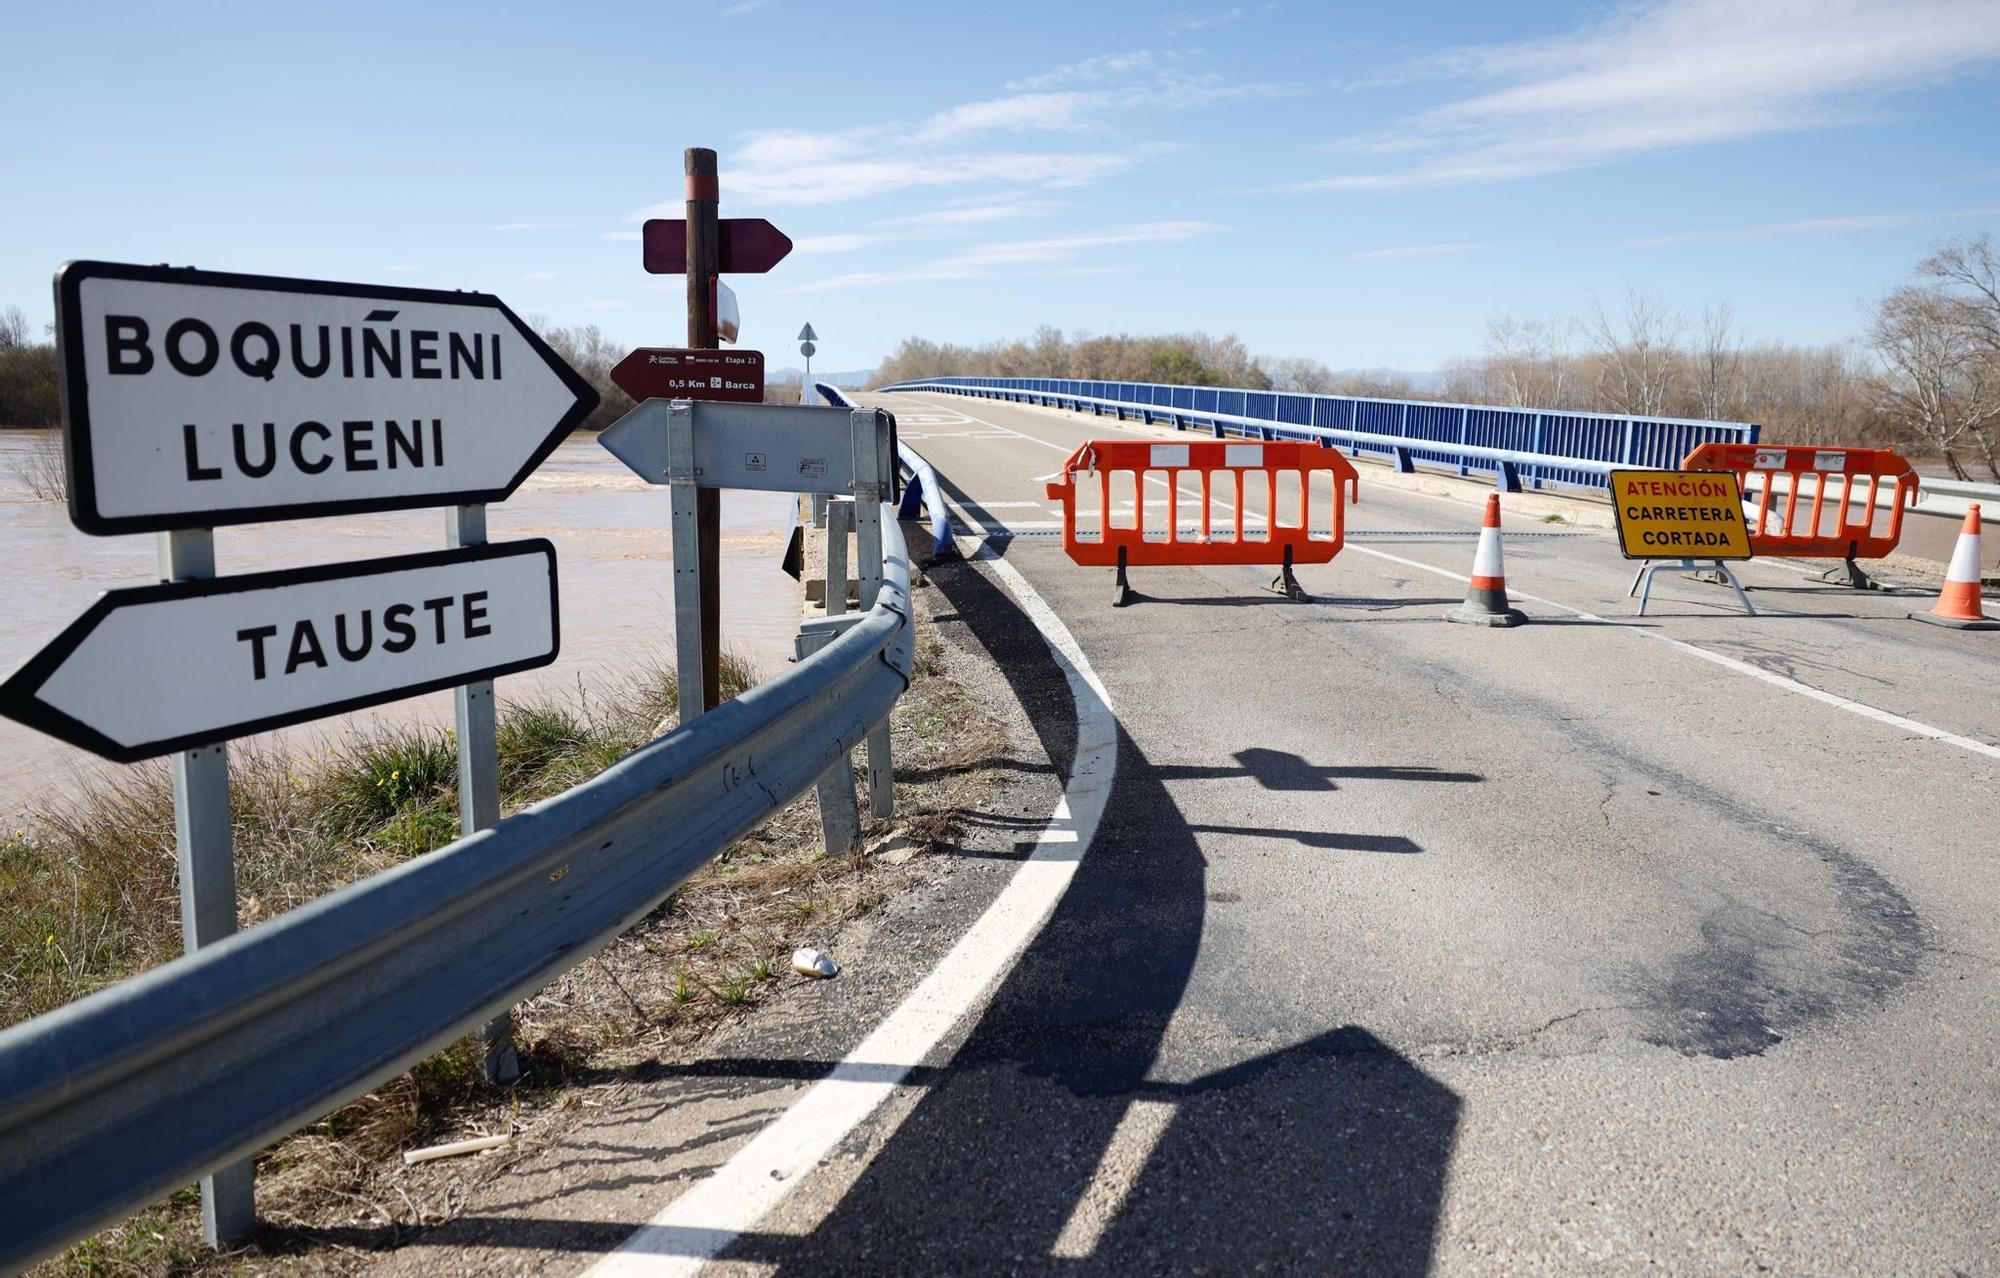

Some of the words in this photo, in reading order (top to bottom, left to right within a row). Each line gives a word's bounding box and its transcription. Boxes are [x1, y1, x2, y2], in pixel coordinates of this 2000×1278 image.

[105, 310, 502, 382] BOQUIÑENI
[726, 356, 745, 365] Etapa
[669, 379, 685, 389] 0,5
[688, 379, 705, 388] Km
[725, 381, 755, 390] Barca
[183, 419, 444, 481] LUCENI
[1627, 479, 1727, 497] ATENCIÓN
[1627, 507, 1736, 522] CARRETERA
[1643, 531, 1730, 546] CORTADA
[236, 590, 492, 680] TAUSTE
